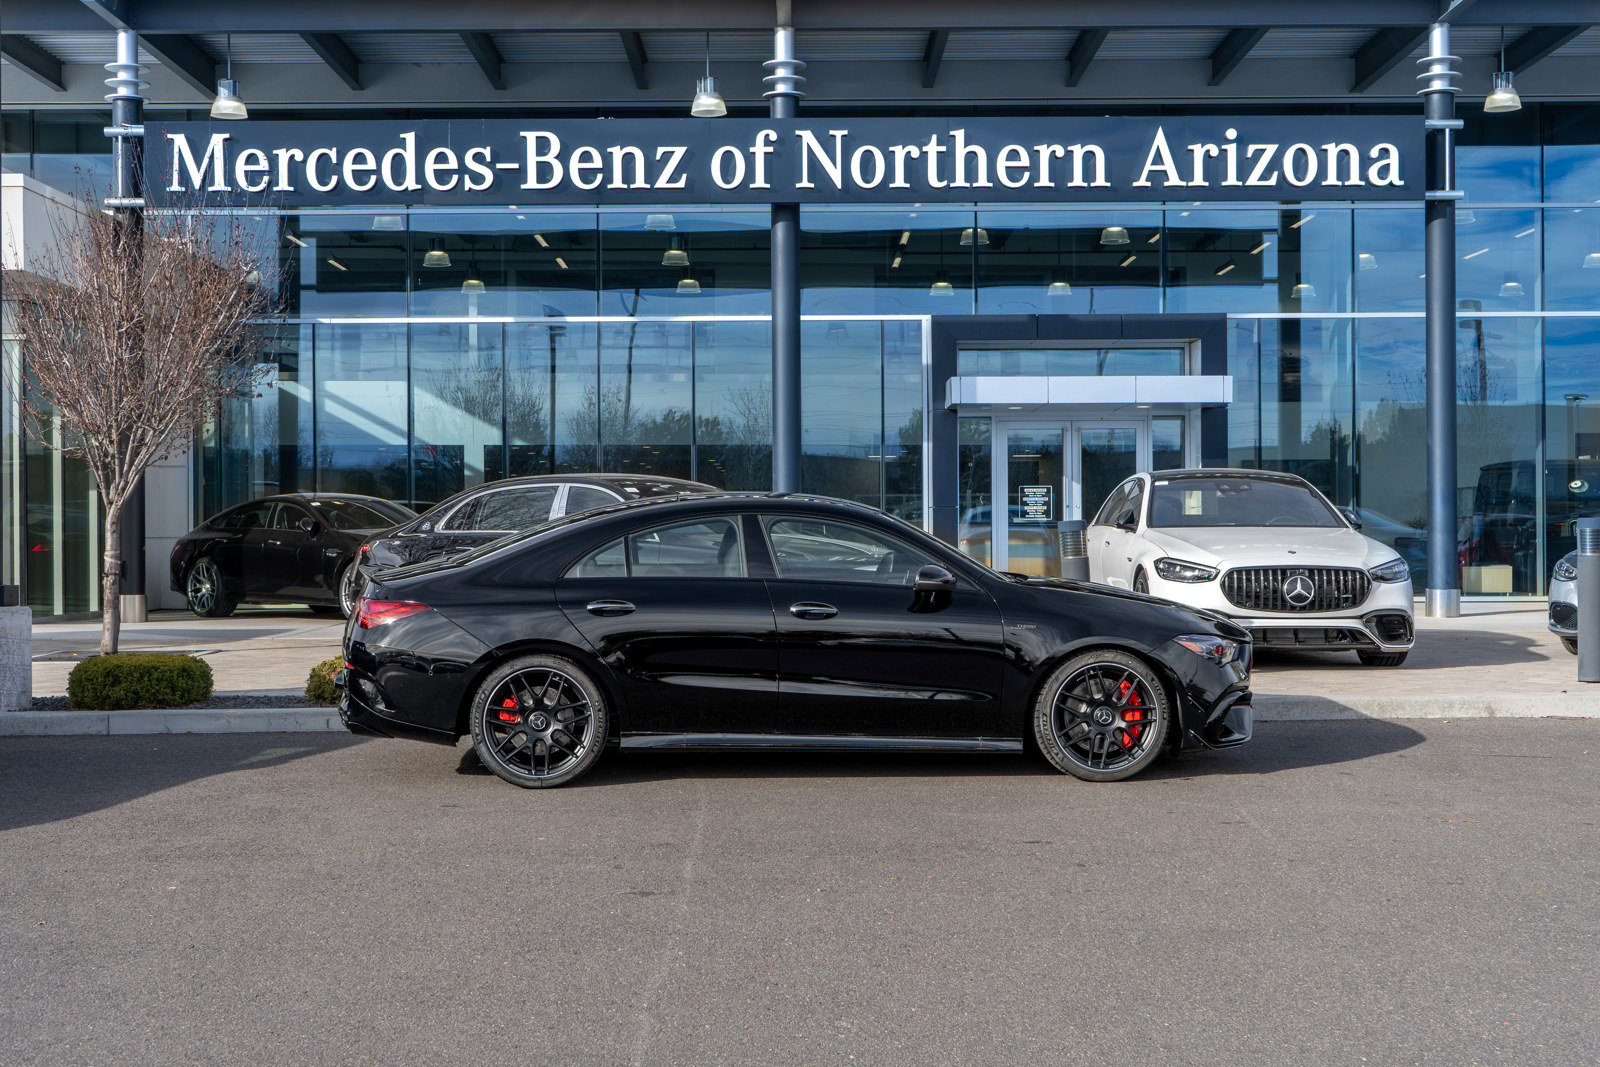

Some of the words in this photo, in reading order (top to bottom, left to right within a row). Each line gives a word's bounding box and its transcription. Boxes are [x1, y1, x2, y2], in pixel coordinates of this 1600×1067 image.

[166, 131, 688, 192] Mercedes-Benz
[710, 129, 778, 189] of
[795, 128, 1111, 190] Northern
[1132, 125, 1405, 187] Arizona
